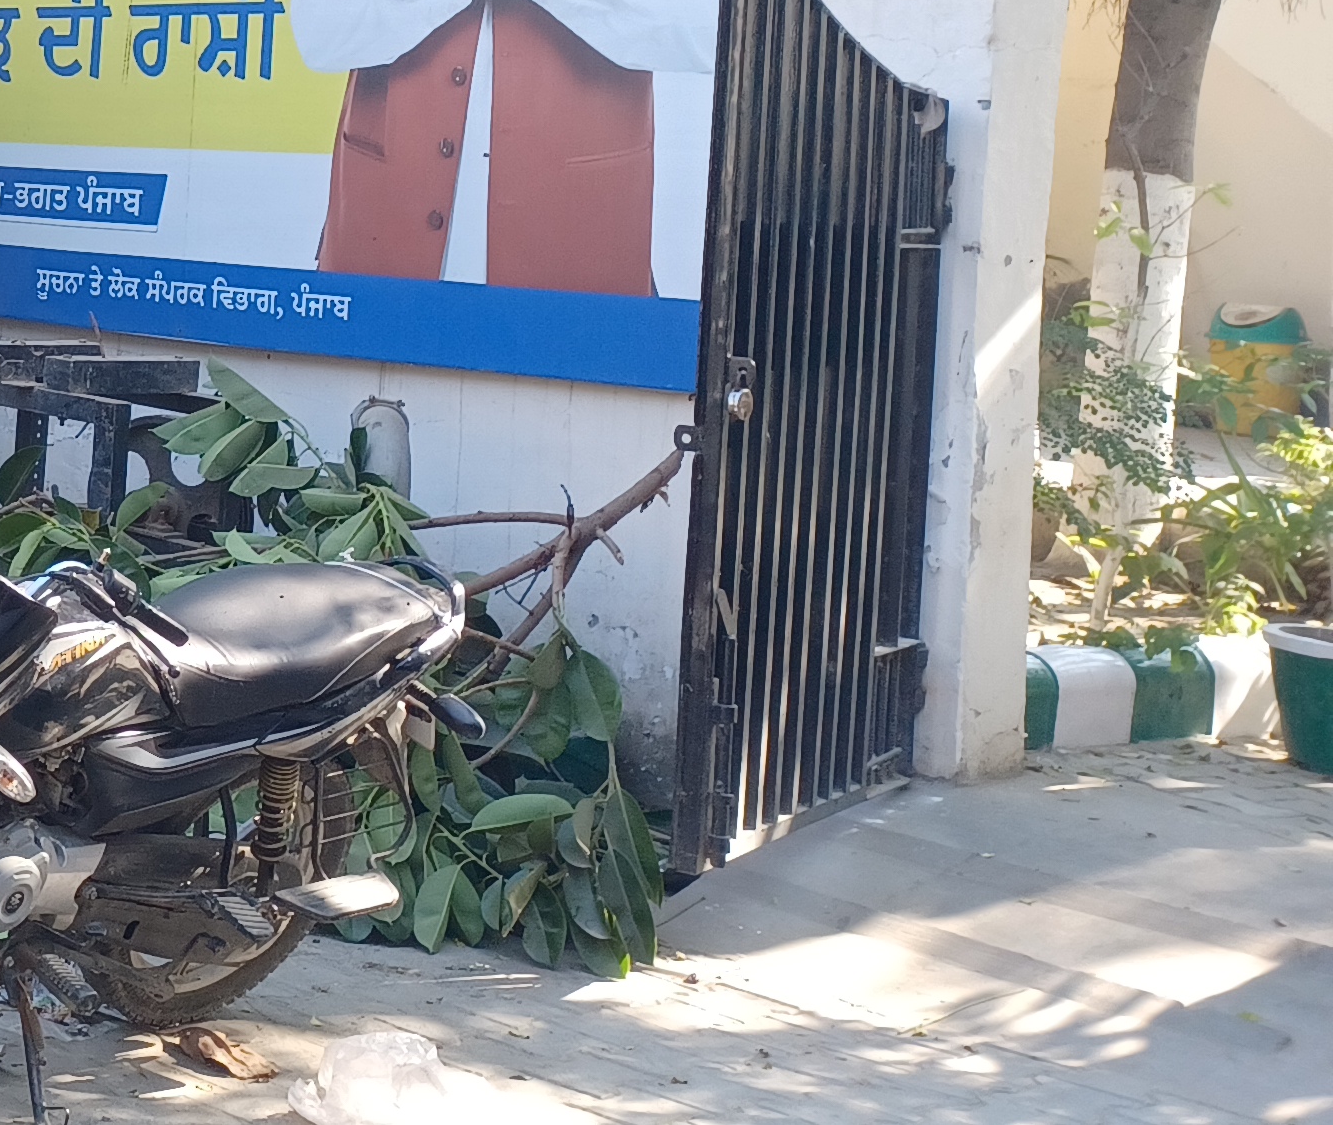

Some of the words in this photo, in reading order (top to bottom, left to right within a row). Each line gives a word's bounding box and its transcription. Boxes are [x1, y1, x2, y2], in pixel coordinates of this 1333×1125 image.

[76, 175, 144, 217] ਪੰਜਾਬ
[36, 268, 86, 301] ਸੂਚਨਾ
[88, 264, 104, 297] ਤੇ
[107, 266, 141, 301] ਲੋਕ
[145, 270, 207, 308] ਸੰਪਰਕ
[210, 276, 284, 320] ਵਿਭਾਗ,
[290, 282, 353, 321] ਪੰਜਾਬ
